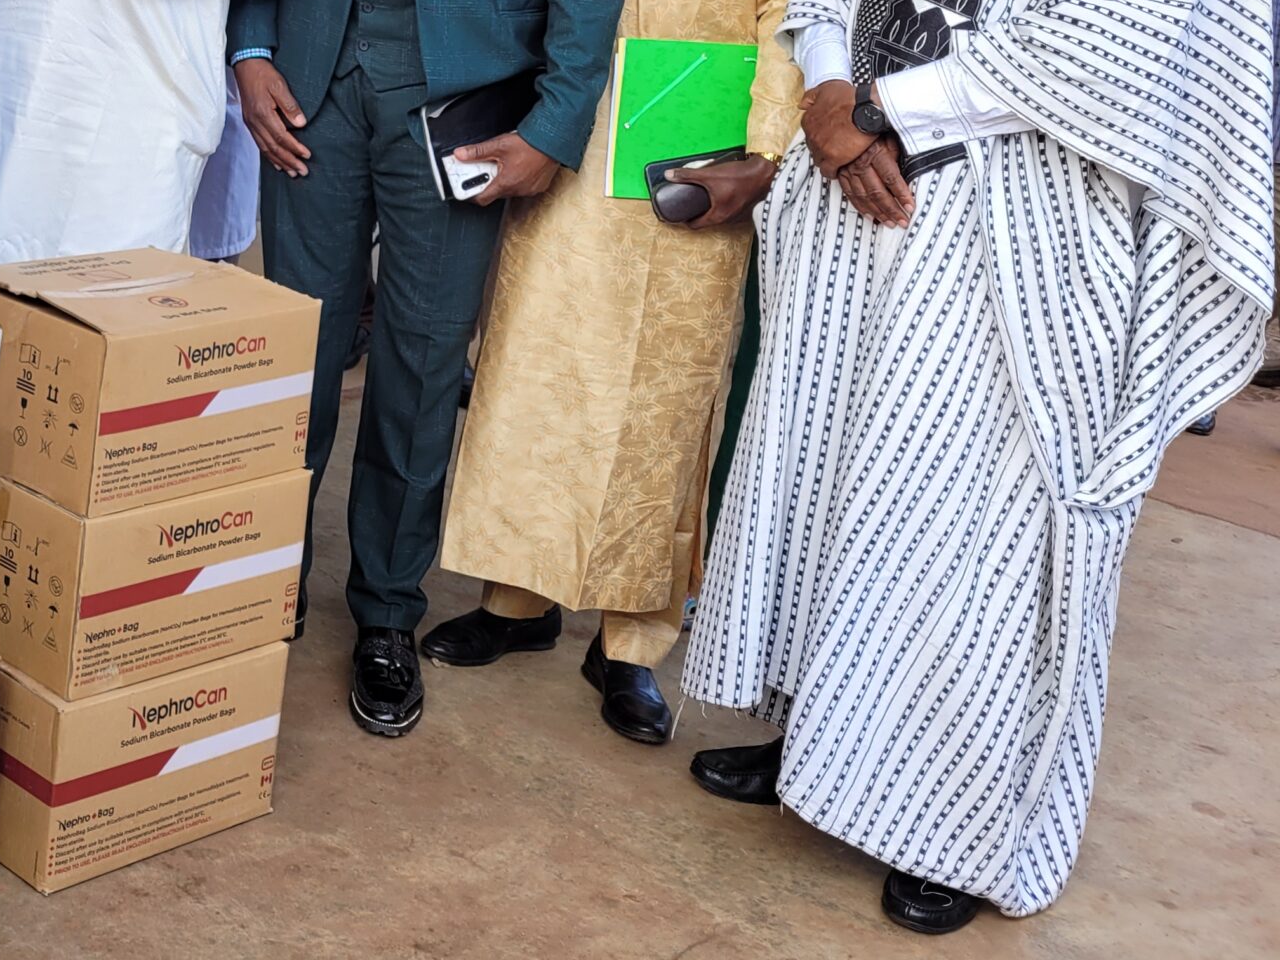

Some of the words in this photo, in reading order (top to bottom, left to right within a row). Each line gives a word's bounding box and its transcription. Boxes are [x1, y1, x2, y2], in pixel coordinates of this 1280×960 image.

[177, 336, 265, 368] NephroCan
[166, 374, 192, 384] Sodium
[193, 366, 232, 379] Bicarbonate
[233, 361, 257, 371] Powder
[258, 358, 273, 366] Bags
[159, 511, 252, 547] NephroCan
[147, 553, 174, 564] Sodium
[175, 542, 216, 557] Bicarbonate
[217, 536, 243, 547] Powder
[244, 531, 261, 541] Bags
[131, 687, 227, 729] NephroCan
[120, 734, 148, 748] Sodium
[149, 721, 191, 739] Bicarbonate
[192, 712, 218, 725] Powder
[219, 707, 235, 717] Bags
